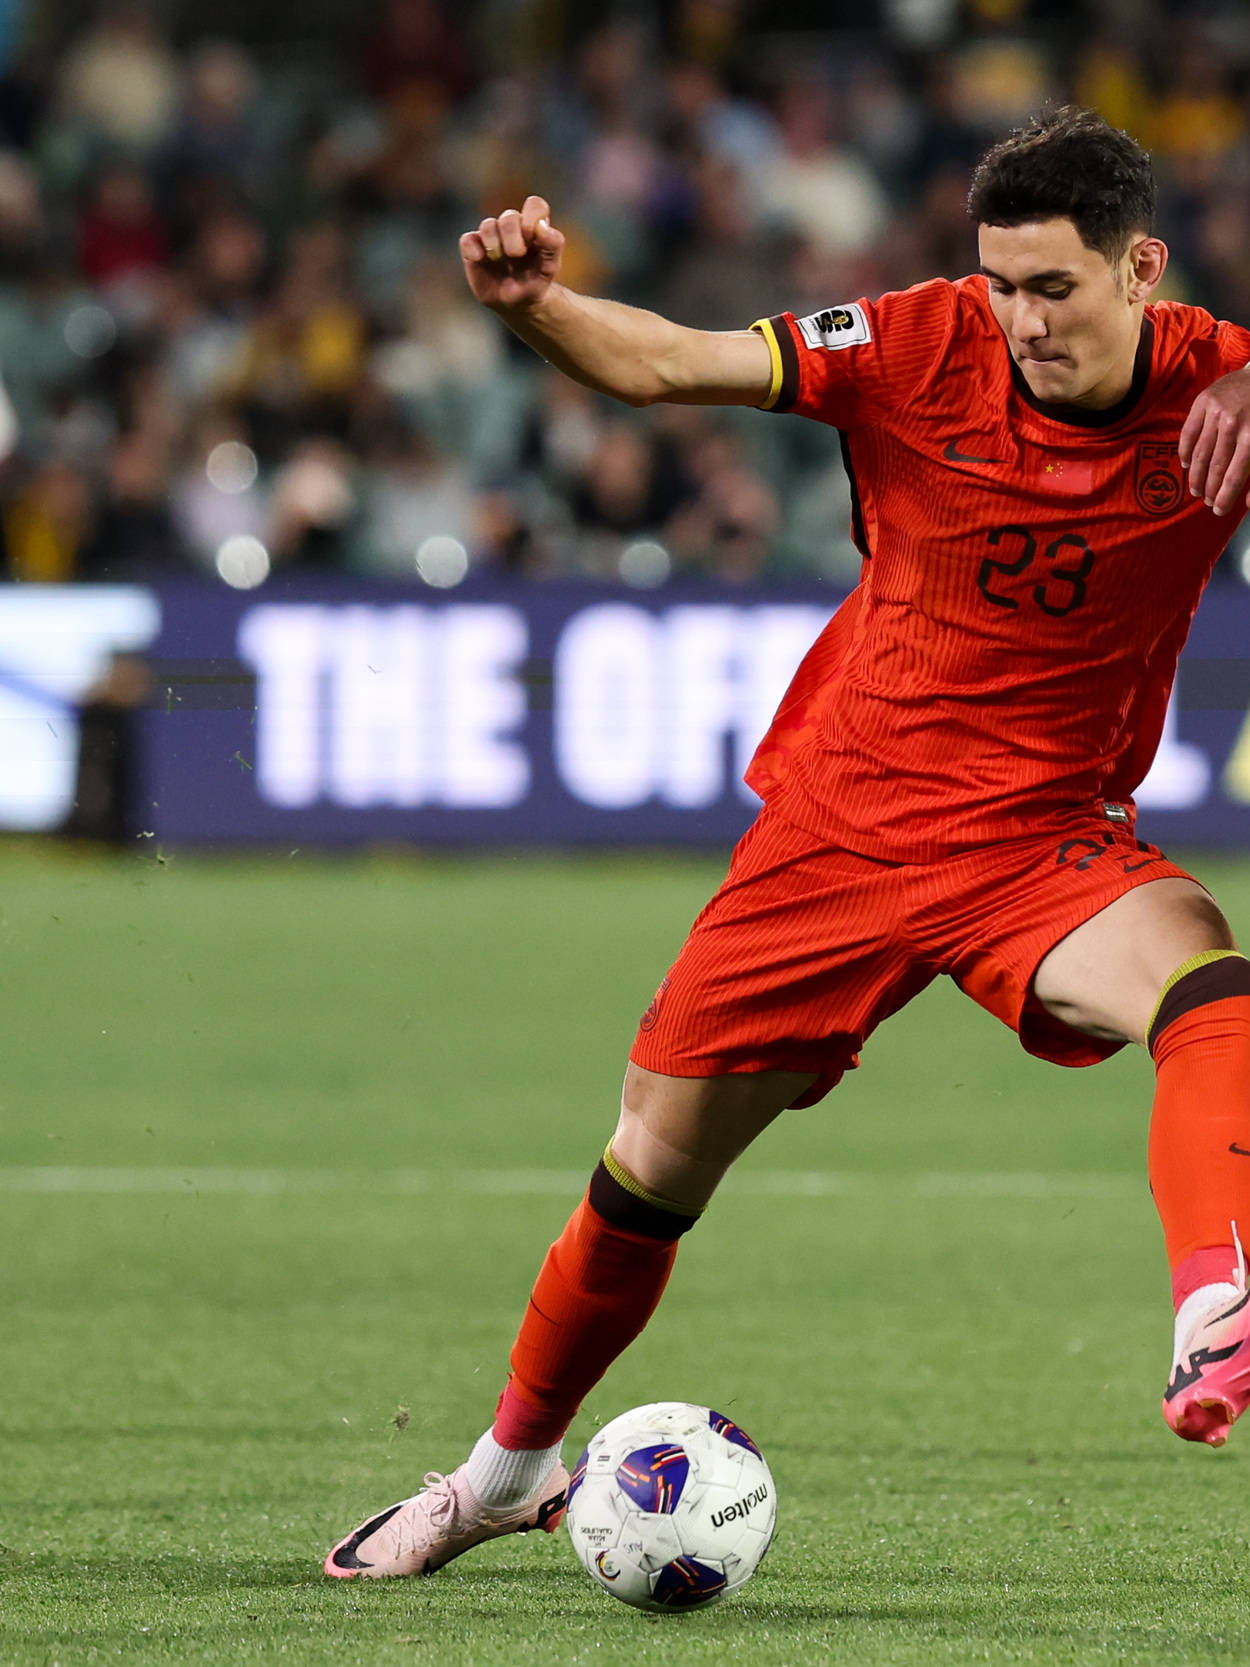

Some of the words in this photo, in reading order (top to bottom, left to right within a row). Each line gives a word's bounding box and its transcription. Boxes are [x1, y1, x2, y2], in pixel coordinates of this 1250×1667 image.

[976, 524, 1096, 617] 23
[239, 603, 530, 809] THE
[710, 1482, 768, 1529] molten
